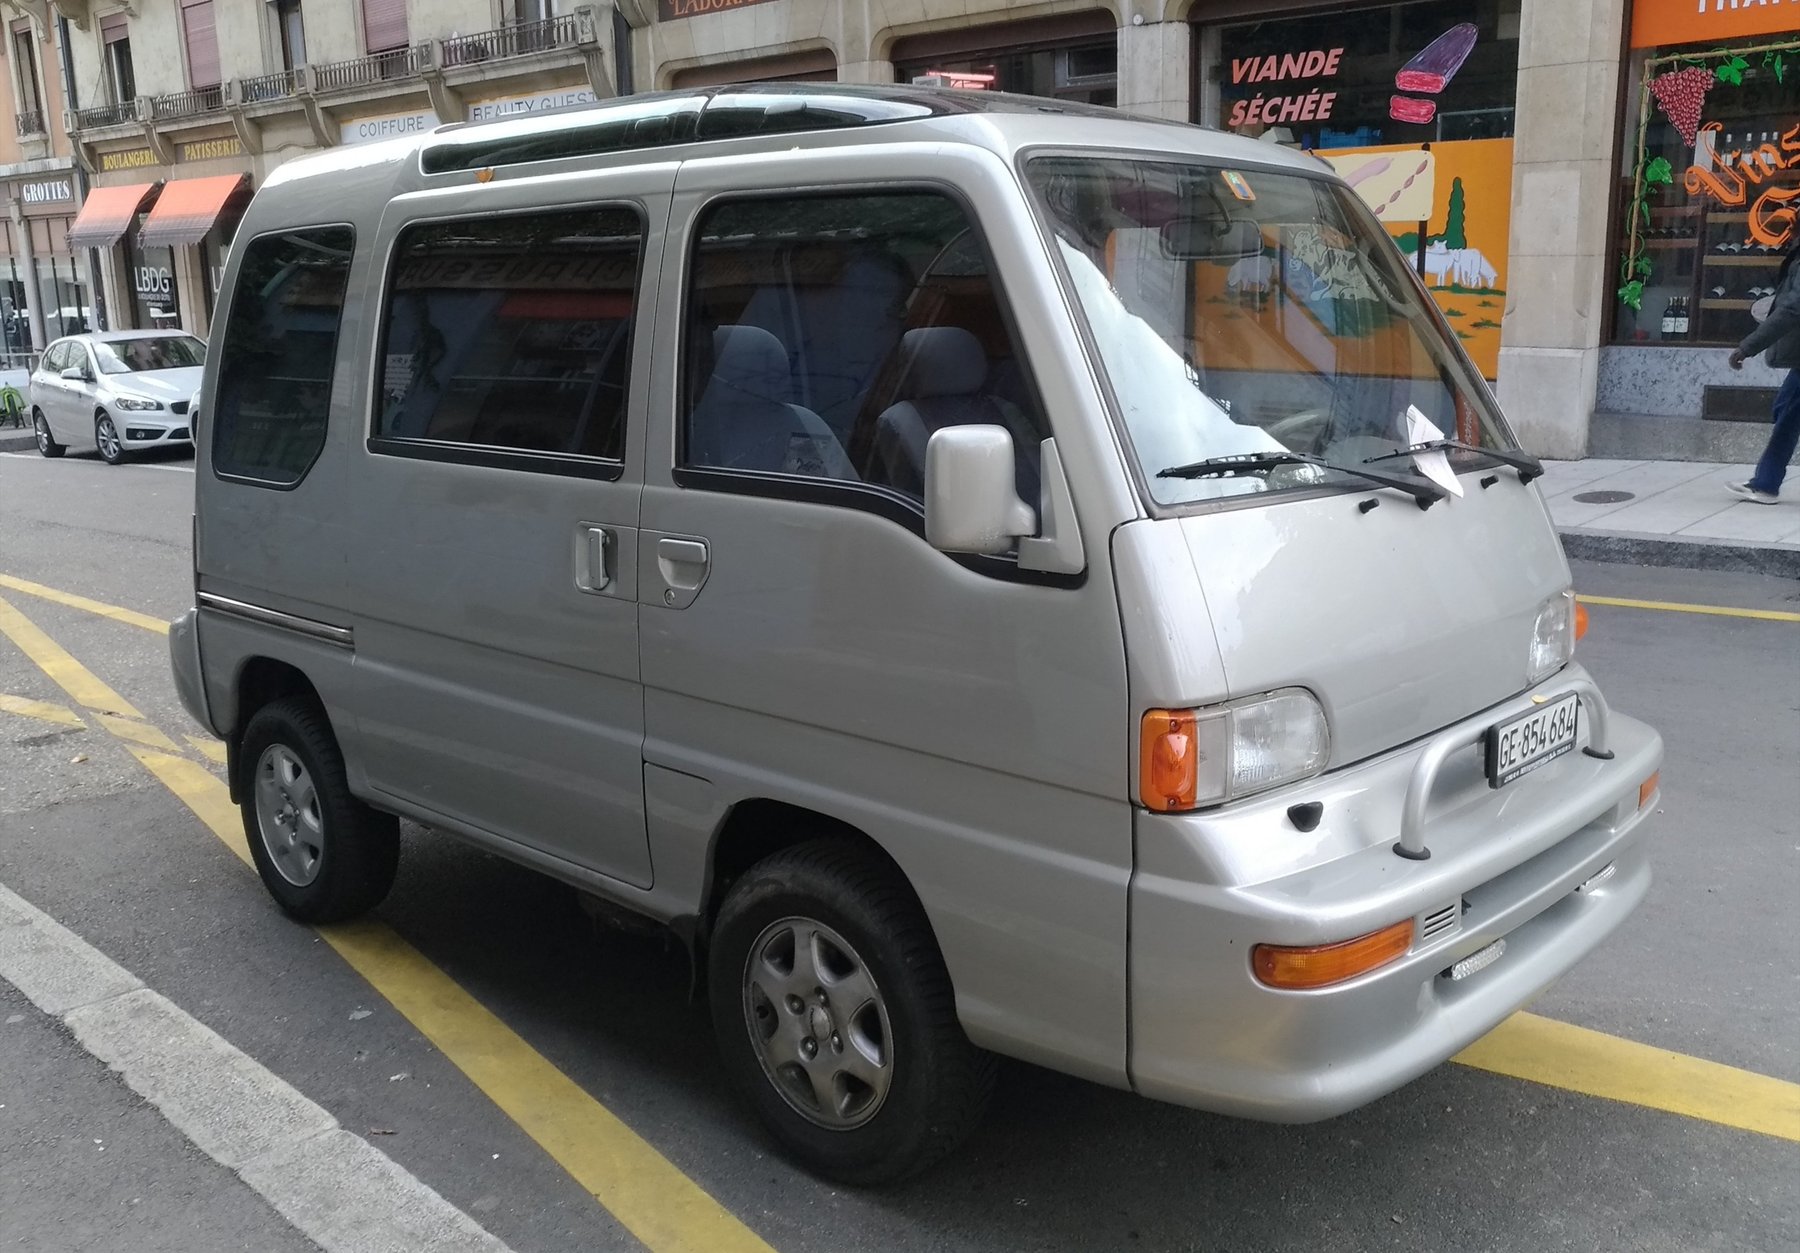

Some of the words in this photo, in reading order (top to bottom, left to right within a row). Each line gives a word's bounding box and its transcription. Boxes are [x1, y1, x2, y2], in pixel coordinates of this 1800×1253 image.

[1231, 47, 1344, 85] VIANDE
[1228, 87, 1338, 127] SÉCHÉE
[359, 116, 425, 138] COIFFURE
[184, 139, 241, 161] PATISSERIE
[23, 180, 70, 202] GROTTES
[134, 266, 170, 294] LBDG
[1549, 702, 1574, 745] 684
